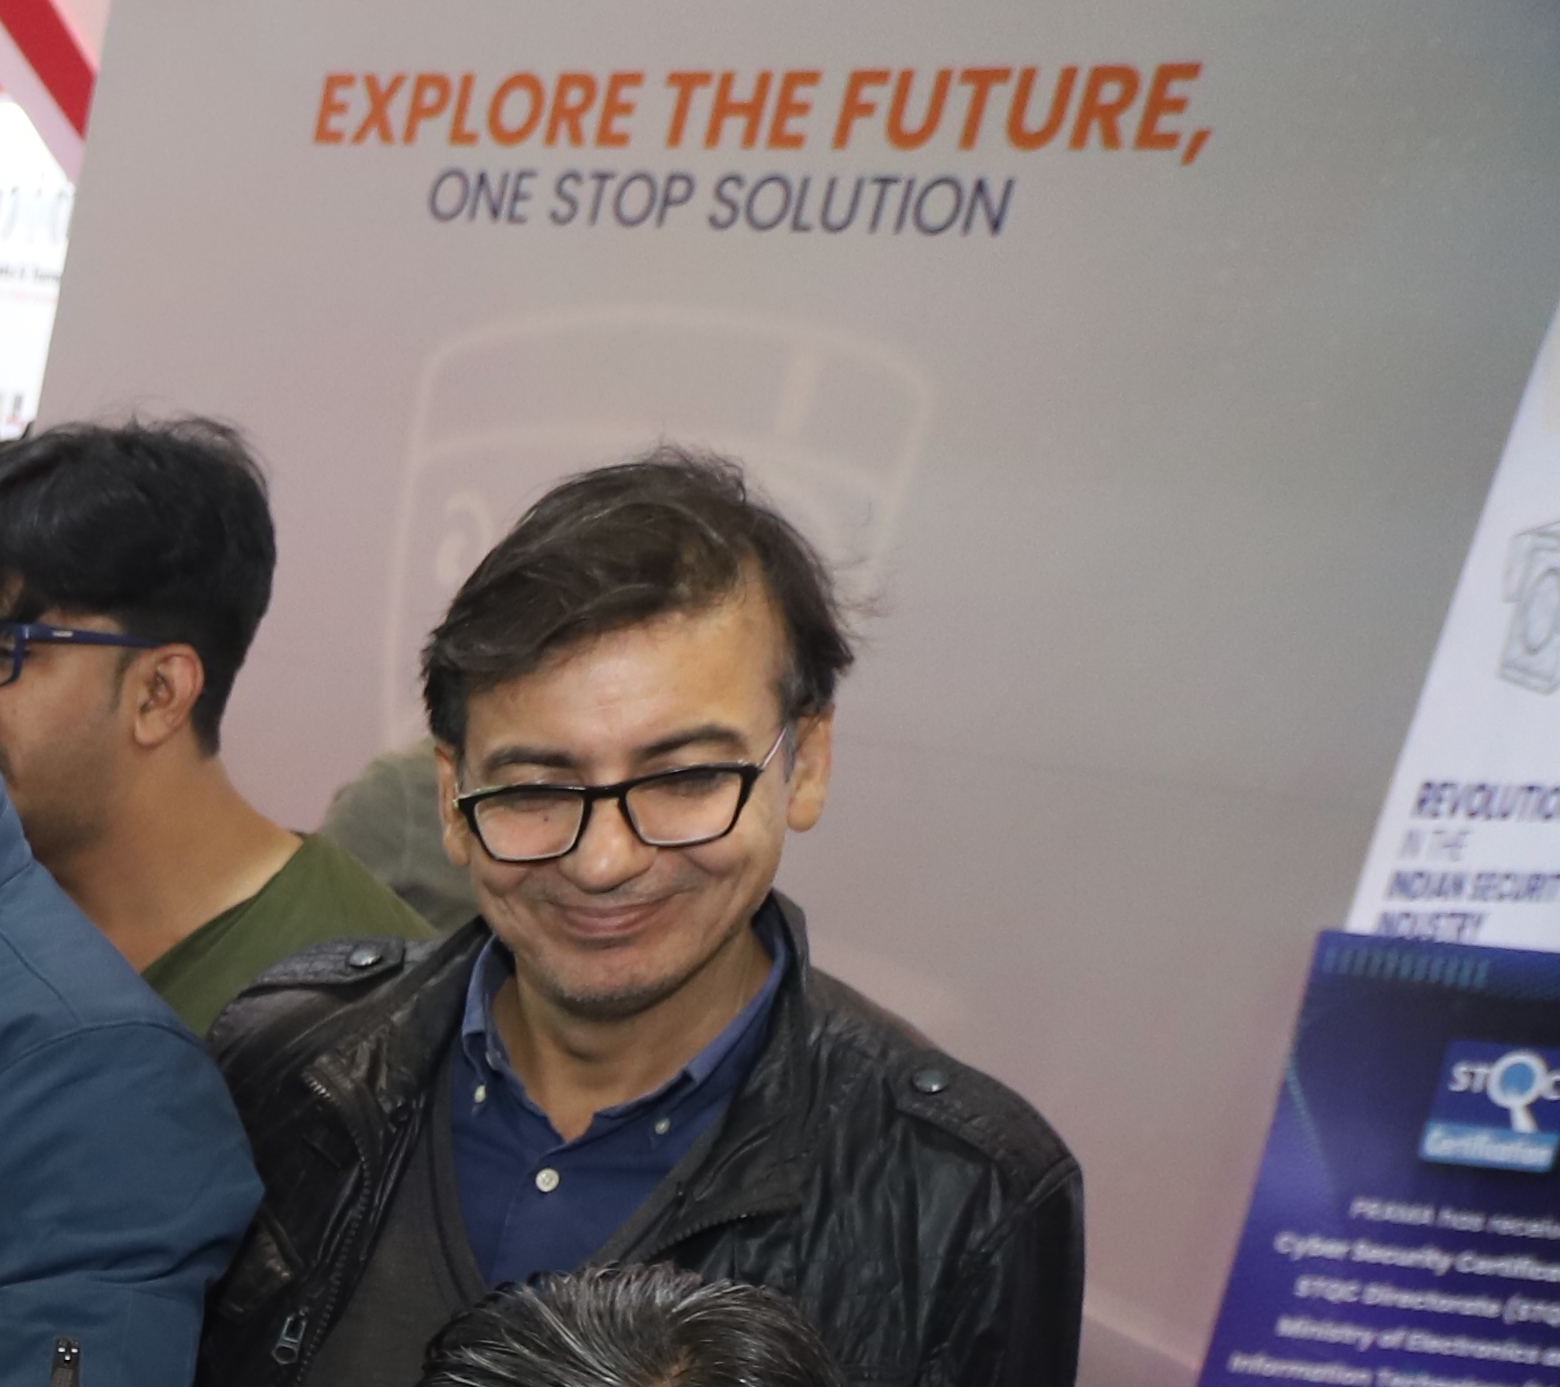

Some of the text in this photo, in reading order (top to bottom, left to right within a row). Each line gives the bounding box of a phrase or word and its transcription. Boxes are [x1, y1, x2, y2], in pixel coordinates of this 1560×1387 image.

[314, 60, 1213, 166] EXPLORE THE FUTURE,
[427, 167, 1017, 237] ONE STOP SOLUTION
